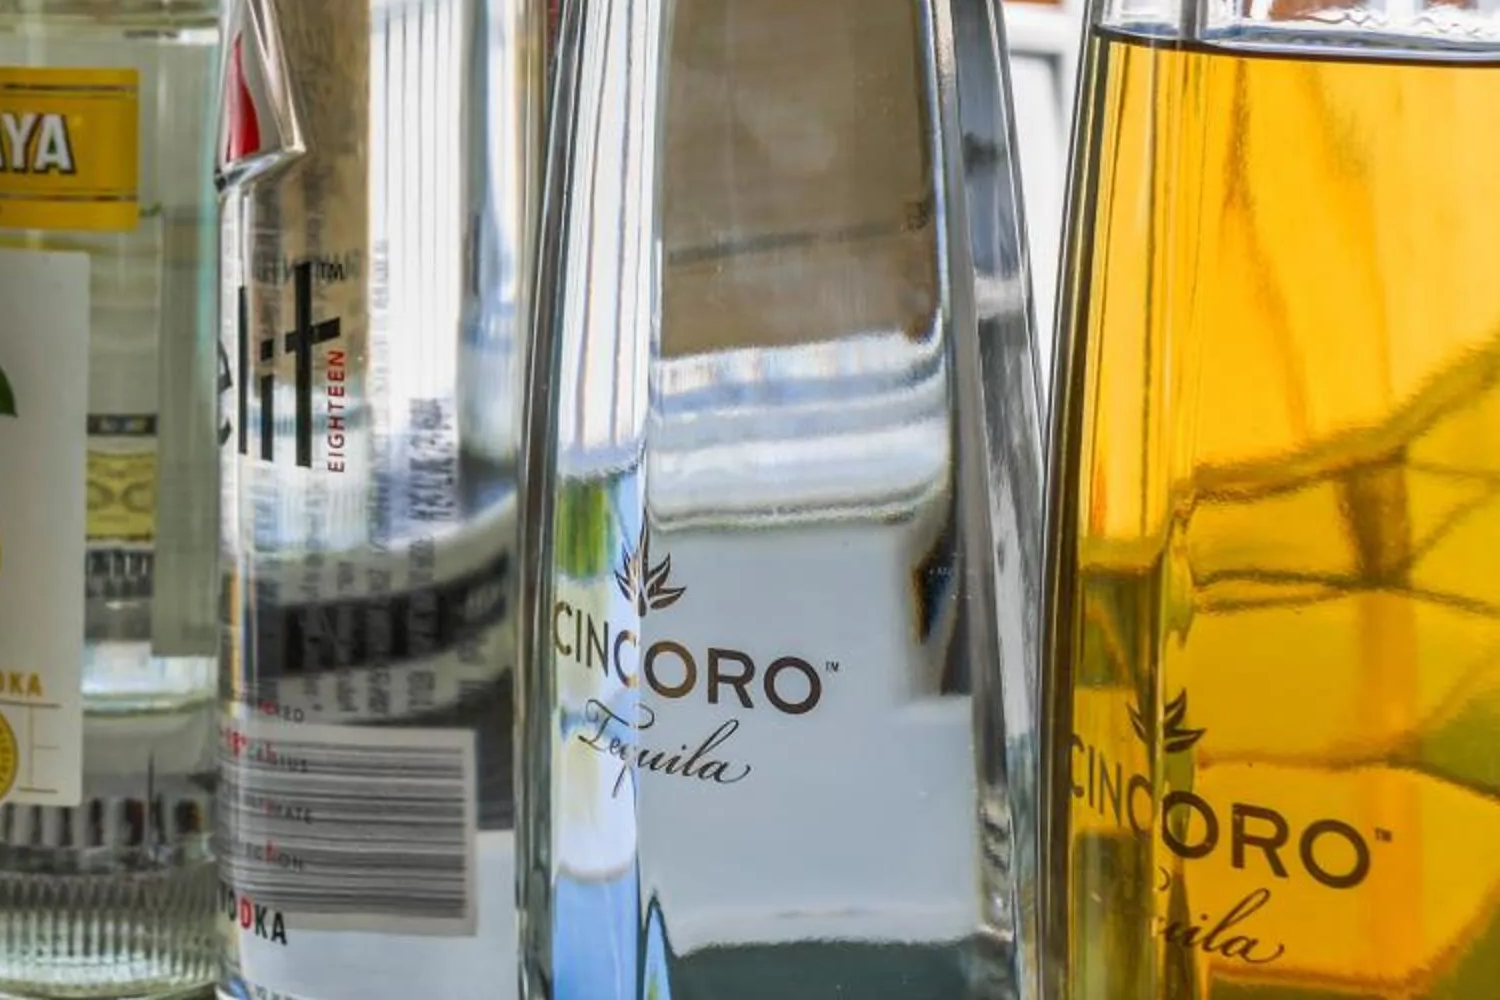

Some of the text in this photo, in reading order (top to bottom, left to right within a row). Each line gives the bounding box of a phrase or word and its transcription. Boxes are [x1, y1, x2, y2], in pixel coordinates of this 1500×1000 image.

[327, 350, 345, 473] EIGHTEEN
[553, 601, 822, 715] CINCORO
[577, 698, 752, 798] Tequila
[1070, 733, 1371, 889] CINCORO
